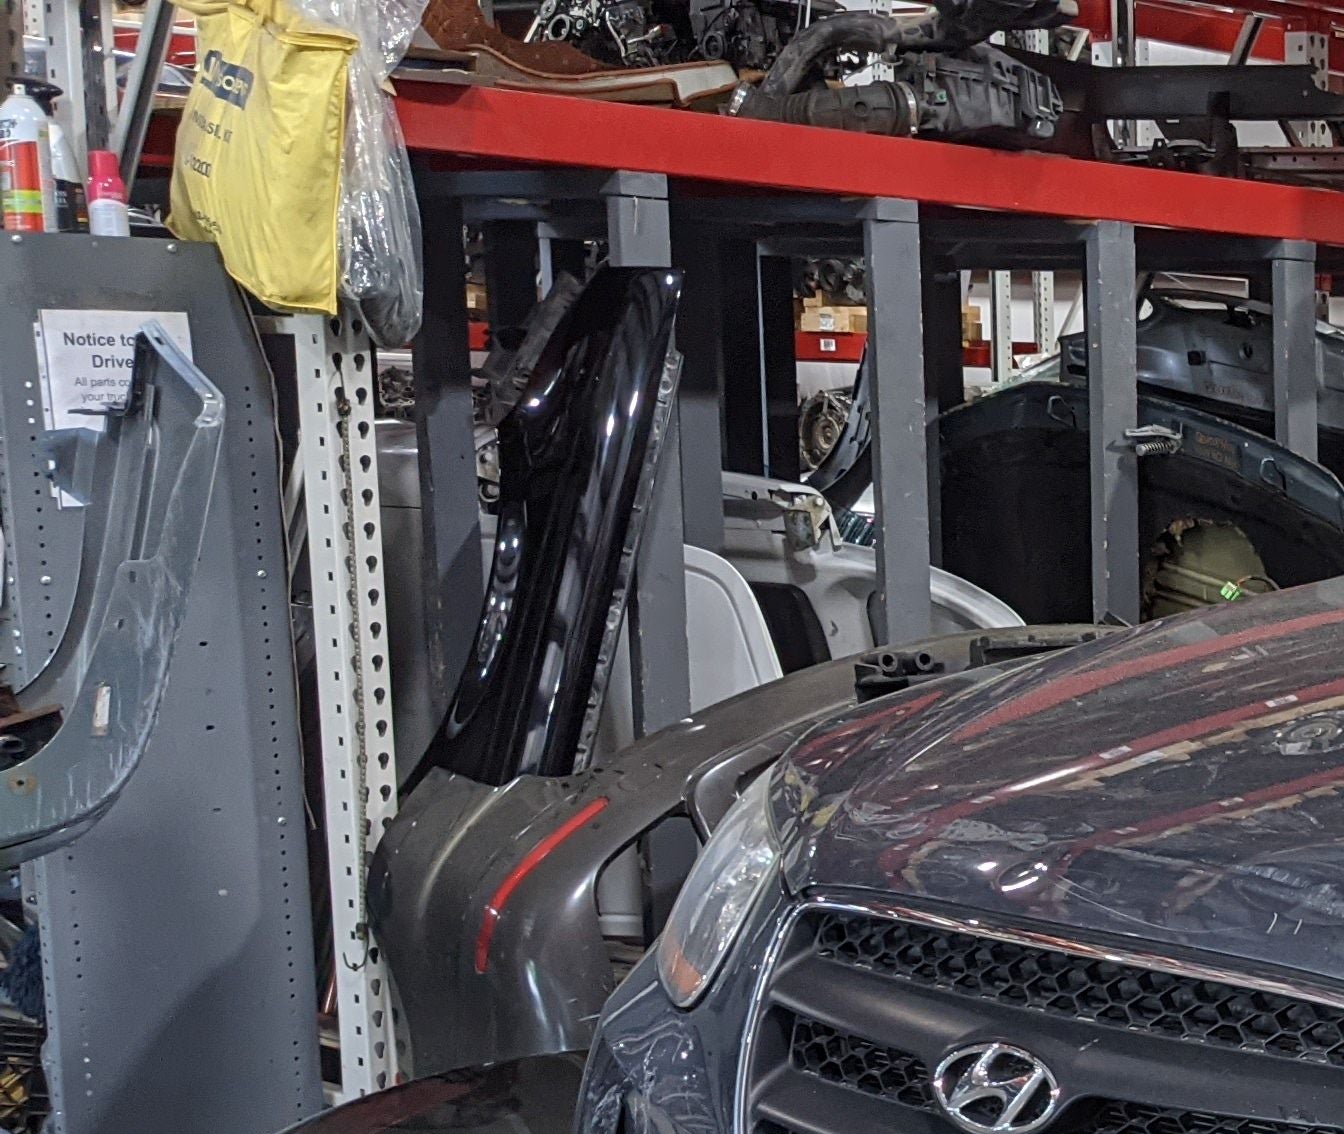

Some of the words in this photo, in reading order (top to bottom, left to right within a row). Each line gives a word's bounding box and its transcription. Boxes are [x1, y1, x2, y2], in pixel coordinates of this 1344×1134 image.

[63, 332, 116, 347] Notice
[74, 376, 88, 387] All
[90, 378, 117, 388] parts
[81, 393, 104, 403] your
